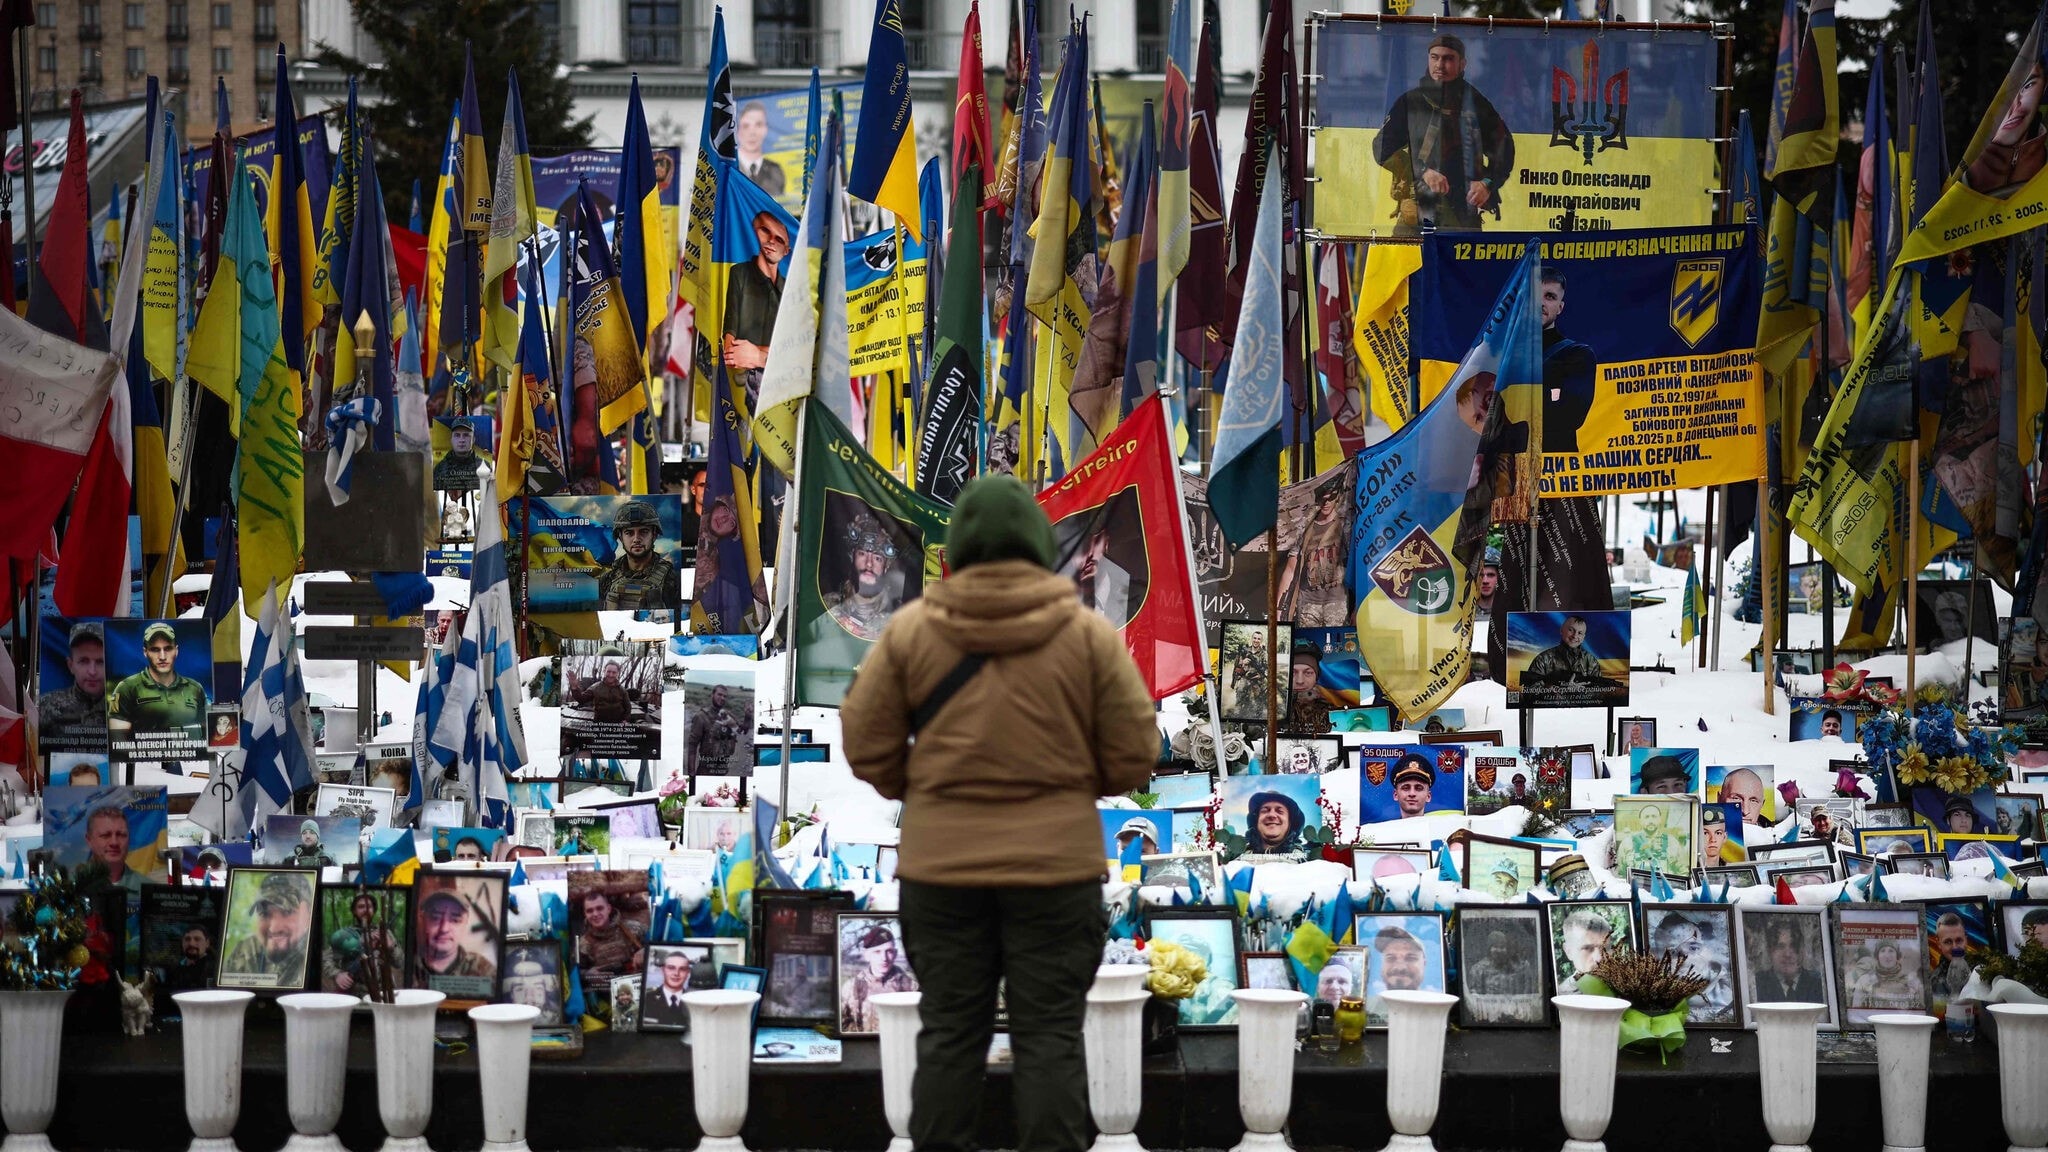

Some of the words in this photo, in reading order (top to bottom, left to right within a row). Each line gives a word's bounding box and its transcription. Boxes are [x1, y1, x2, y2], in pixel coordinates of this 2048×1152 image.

[1251, 57, 1268, 201] НО-ШТУРМОВІ
[1520, 169, 1559, 186] Янко
[1562, 170, 1651, 190] Олександр
[477, 197, 492, 208] 58
[1529, 192, 1641, 211] Миколайович
[1549, 215, 1611, 231] «Зізді»
[1454, 244, 1472, 260] 12
[1475, 242, 1549, 260] БРИГА
[1552, 234, 1711, 260] СПЕЦПРИЗНАЧЕННЯ
[1716, 231, 1745, 252] НГУ
[1680, 262, 1719, 274] АЗОВ
[886, 301, 925, 319] 13.1.2022
[1362, 327, 1374, 342] 414
[1604, 365, 1646, 381] ПАНОВ
[1648, 362, 1688, 376] АРТЕМ
[1616, 375, 1683, 395] ПОЗИВНИЙ
[1684, 368, 1753, 389] «АККЕРМАН»
[1650, 392, 1705, 404] 05.02.1997
[1624, 406, 1670, 420] ЗАГИНУВ
[1672, 404, 1692, 417] ПРИ
[1693, 398, 1745, 415] ВИКОНАННІ
[1633, 418, 1686, 432] БОЙОВОГО
[1688, 412, 1738, 429] ЗАВДАННЯ
[1608, 433, 1664, 448] 21.08.2025
[1666, 434, 1675, 444] р.
[1676, 432, 1683, 443] В
[1684, 425, 1739, 443] ДОНЕЦЬКІЙ
[1569, 455, 1580, 471] В
[1583, 449, 1643, 469] НАШИХ
[1646, 444, 1712, 466] СЕРЦЯХ...
[1559, 474, 1579, 492] НЕ
[1582, 468, 1677, 492] ВМИРАЮТЬ!
[537, 518, 590, 527] ШАПОВАЛОВ
[1800, 700, 1820, 709] Герої
[112, 740, 136, 750] ГАНЖА
[137, 738, 167, 749] ОЛЕКСІЙ
[381, 747, 407, 758] KOIRA
[1364, 748, 1375, 756] 95
[1376, 748, 1404, 758] ОДШБр
[1476, 757, 1486, 765] 95
[1487, 758, 1514, 767] ОДШБр
[348, 787, 365, 797] SIPA
[568, 816, 595, 825] ЧОРНИЙ
